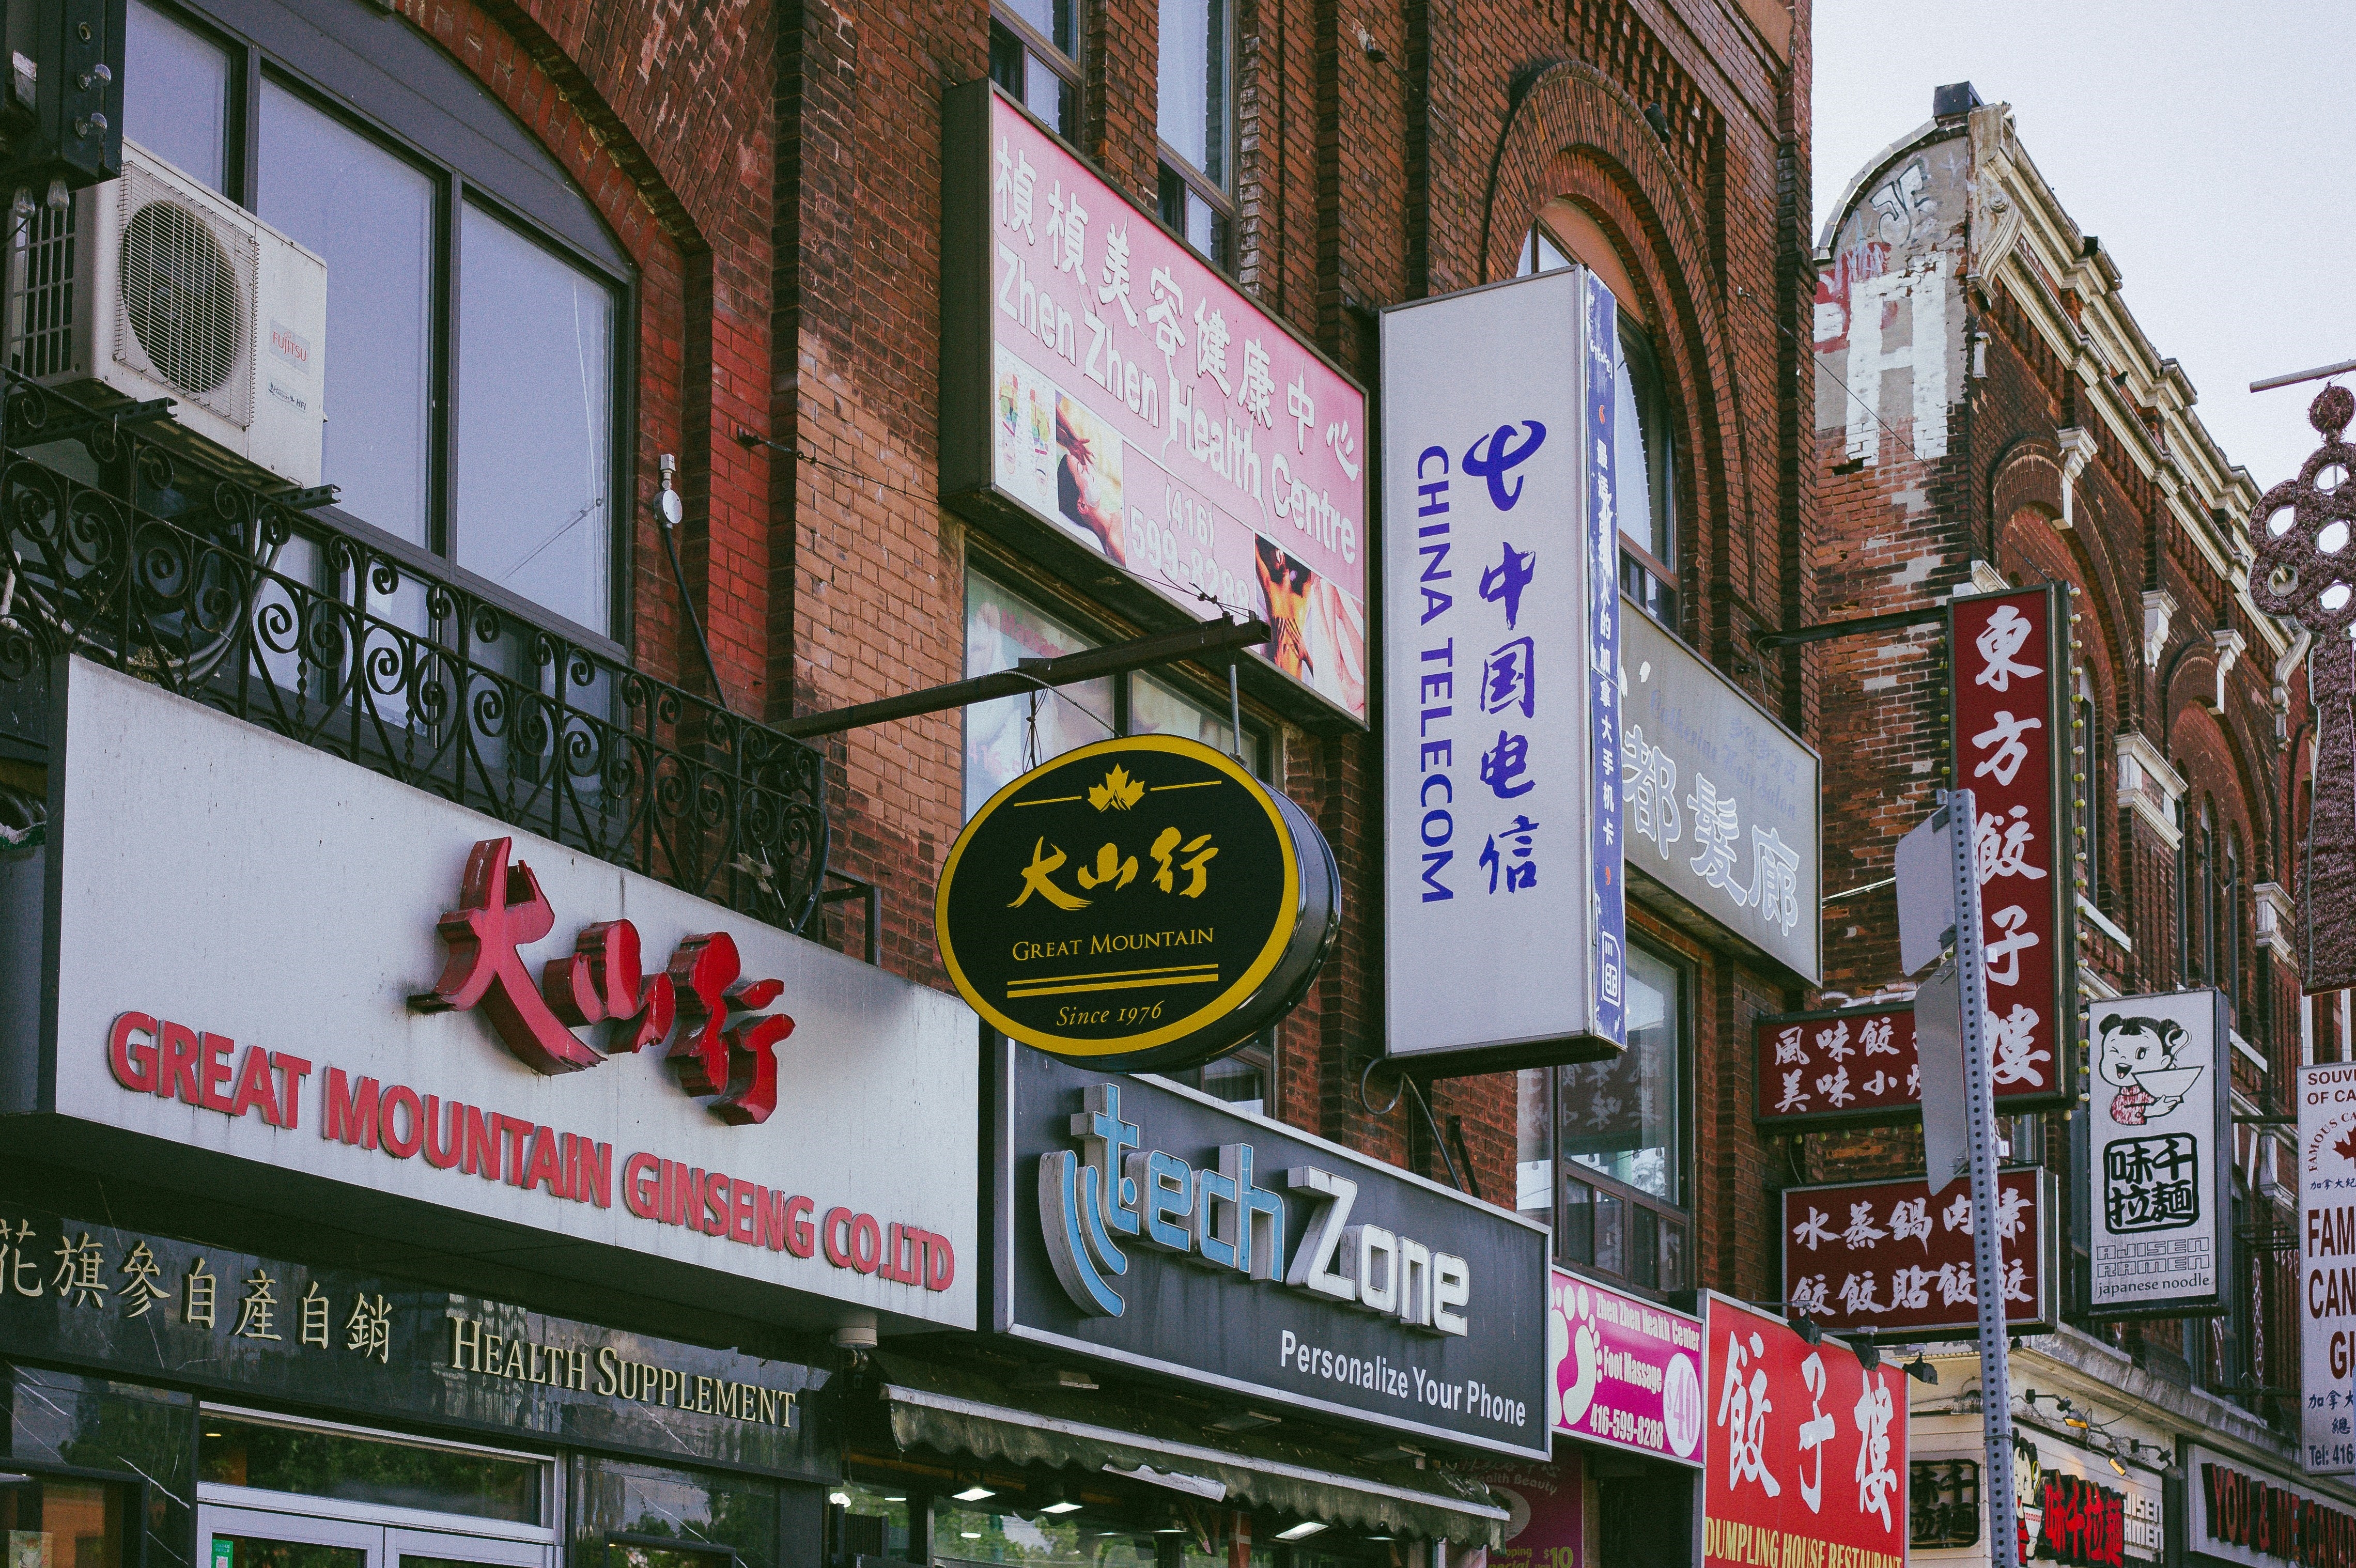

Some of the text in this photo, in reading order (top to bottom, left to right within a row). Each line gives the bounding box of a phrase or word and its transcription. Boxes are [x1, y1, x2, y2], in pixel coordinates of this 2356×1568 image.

[273, 331, 307, 362] FUJITSU
[296, 398, 306, 410] HFI
[998, 240, 1357, 565] Zhen Zhen Health Centre
[1164, 481, 1214, 552] (416)
[1417, 445, 1454, 904] CHINA TELECOM
[1478, 541, 1541, 895] 中国电信
[1006, 827, 1219, 911] 大山行
[1012, 927, 1214, 961] GREAT MOUNTAIN
[407, 836, 796, 1127] 大山行
[1056, 1001, 1165, 1026] Since 1976
[1775, 1017, 1918, 1066] 風味餃
[2307, 1068, 2356, 1085] SOUV
[2307, 1091, 2329, 1105] OF
[110, 1011, 312, 1129] GREAT
[323, 1065, 612, 1209] MOUNTAIN
[624, 1152, 815, 1260] GINSENG
[2307, 1117, 2338, 1173] FAMOUS
[2096, 1238, 2209, 1260] AJISEN
[2308, 1206, 2355, 1257] FAM
[2097, 1254, 2210, 1278] RAMEN
[2097, 1273, 2210, 1298] japanese noodle
[1596, 1292, 1700, 1353] Zhen Zhen Health Center
[451, 1316, 796, 1428] HEALTH SUPPLEMENT
[1281, 1329, 1526, 1427] Personalize Your Phone
[1603, 1344, 1662, 1395] Foot Massage
[1589, 1403, 1664, 1450] 416-599-8288
[1716, 1330, 1898, 1534] 餃子樓
[2308, 1445, 2329, 1466] Tel:
[1514, 1473, 1558, 1496] Beauty
[2211, 1463, 2251, 1546] YOU
[2258, 1480, 2270, 1551] &
[2276, 1486, 2300, 1562] ME
[1704, 1516, 1902, 1568] DUMPLING HOUSE RESTA
